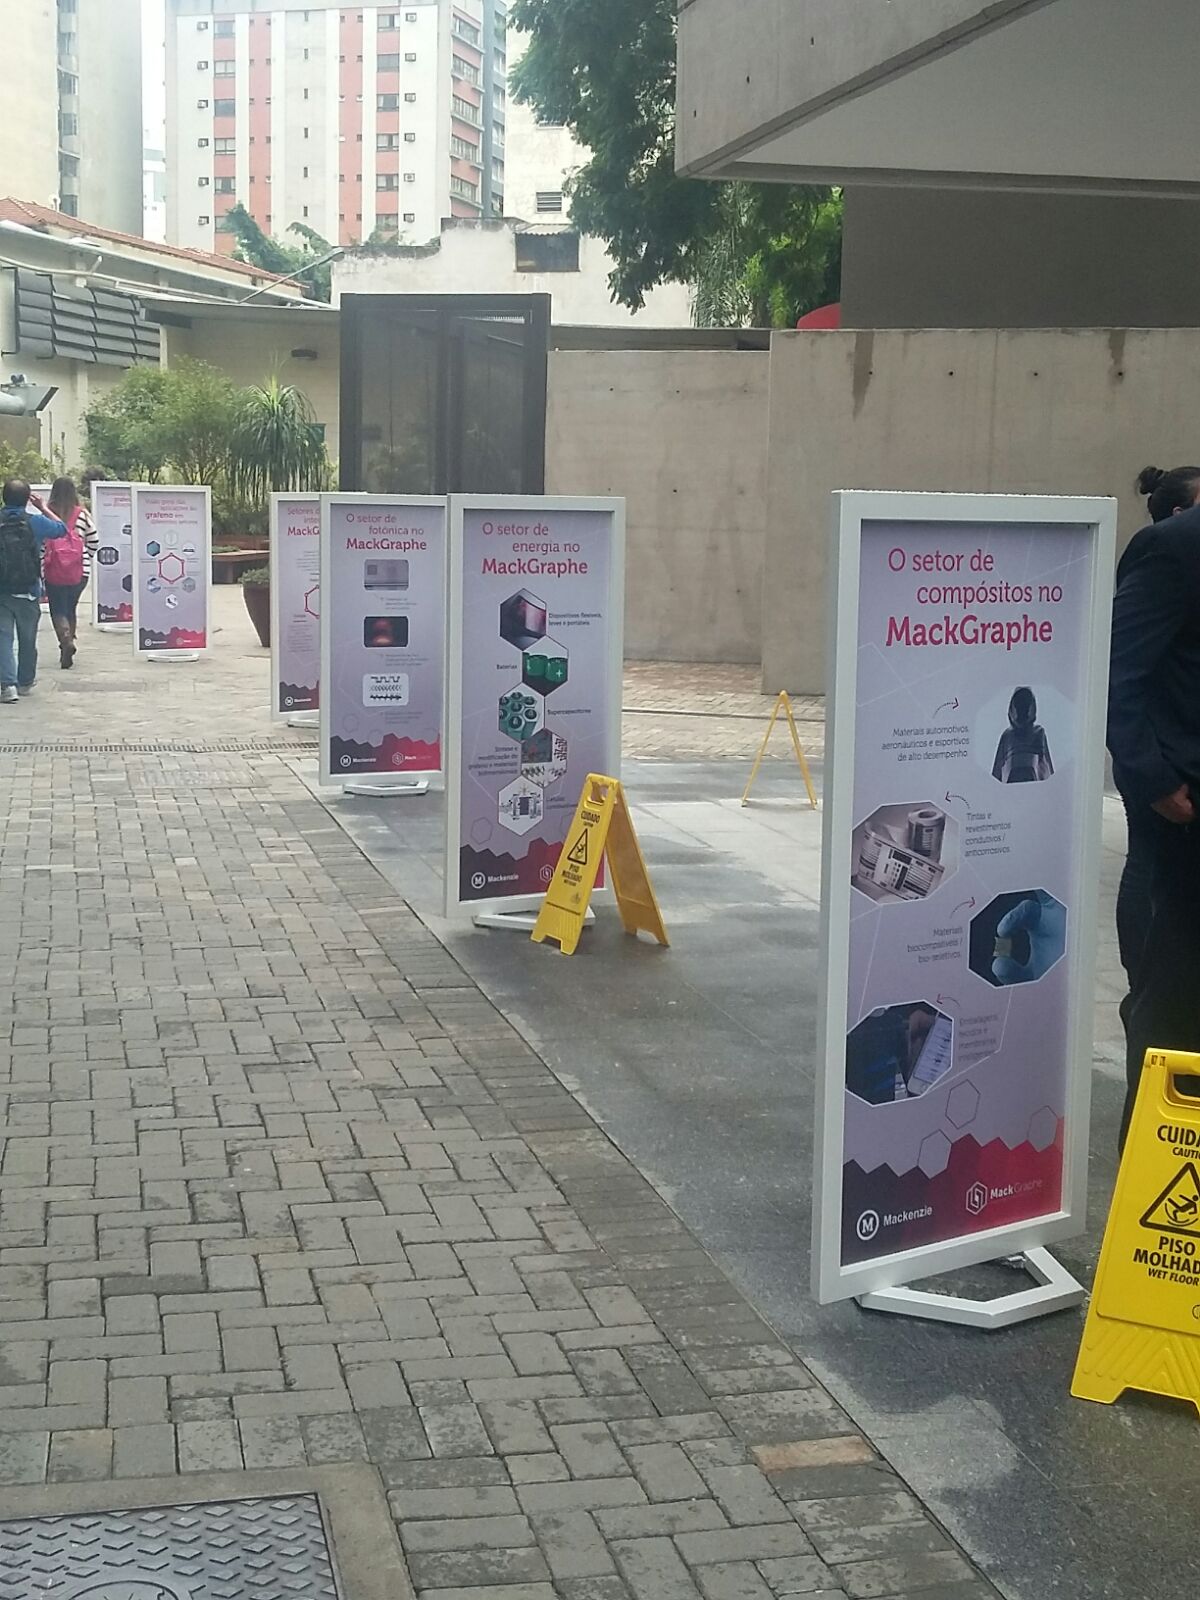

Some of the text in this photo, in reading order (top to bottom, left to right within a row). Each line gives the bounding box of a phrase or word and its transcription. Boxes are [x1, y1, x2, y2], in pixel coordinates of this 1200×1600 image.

[145, 512, 174, 520] grafeno
[346, 513, 397, 523] O setor de
[411, 527, 424, 536] no
[482, 522, 549, 536] O setor de
[346, 537, 427, 552] MackGraphe
[512, 541, 580, 555] energia no
[888, 548, 994, 572] O setor de
[481, 558, 588, 578] MackGraphe
[916, 580, 1063, 610] compósitos no
[885, 614, 1053, 651] MackGraphe
[897, 753, 907, 762] de
[908, 752, 922, 761] alto
[487, 873, 519, 883] Mackenzie
[1172, 1146, 1200, 1160] CAUTI
[883, 1205, 933, 1227] Mackenzie
[1158, 1235, 1196, 1256] PISO
[1148, 1267, 1200, 1287] WET FLOOR
